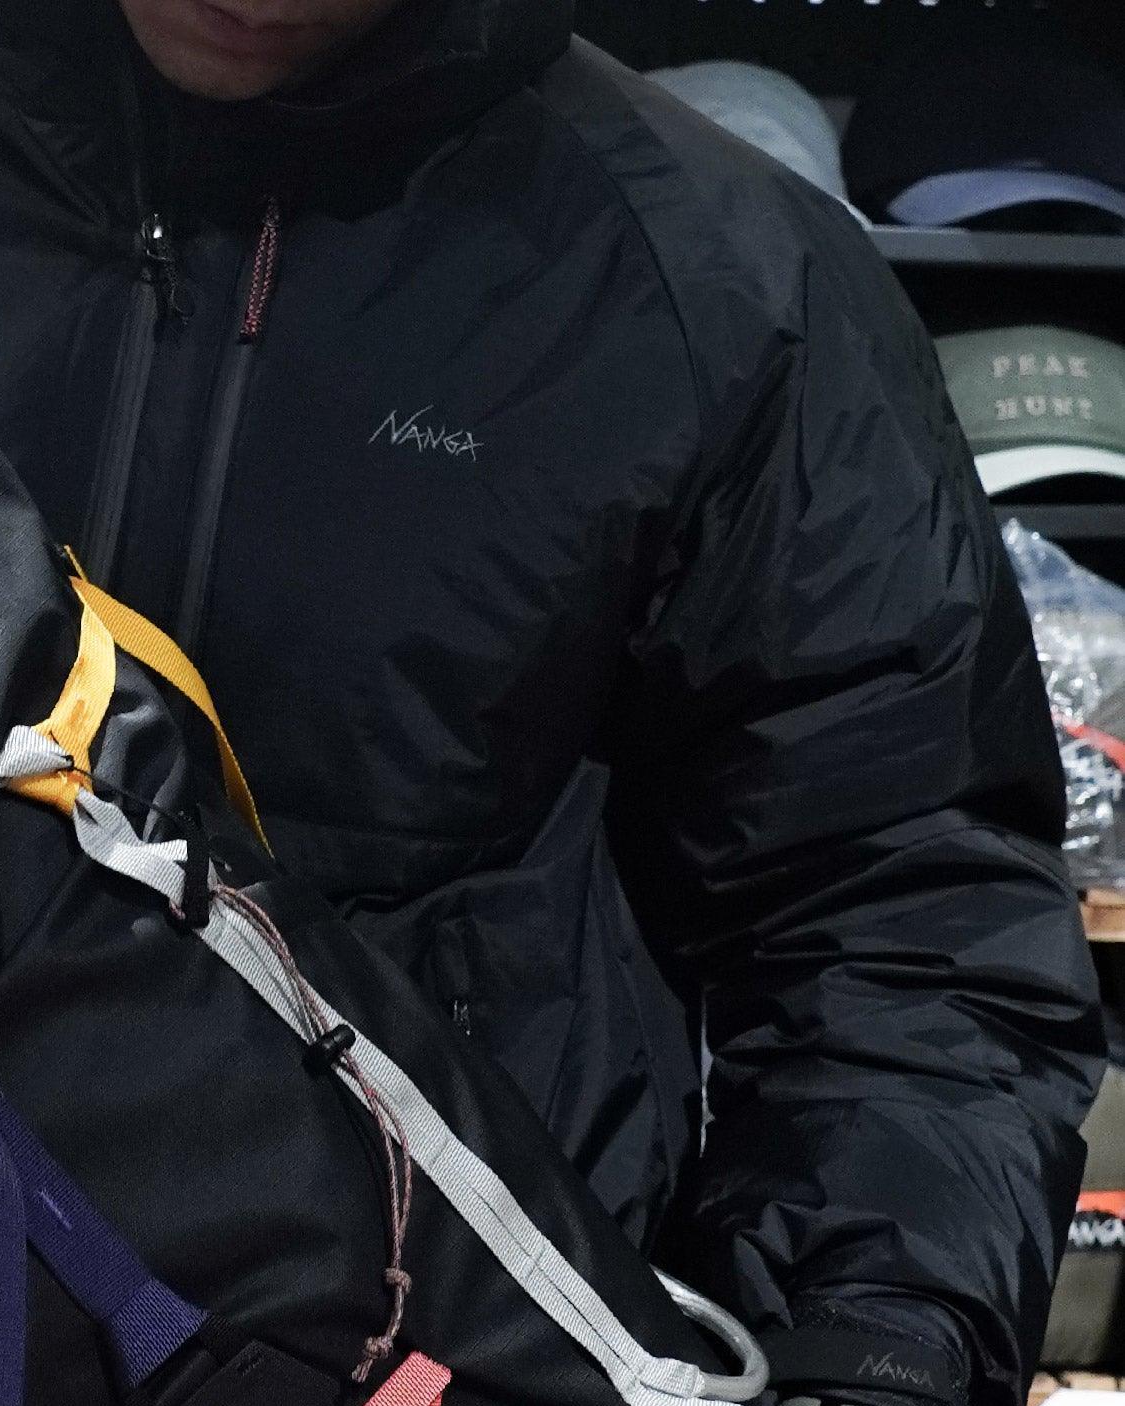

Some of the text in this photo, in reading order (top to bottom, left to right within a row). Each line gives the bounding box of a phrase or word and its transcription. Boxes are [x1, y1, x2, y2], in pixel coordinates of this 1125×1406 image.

[992, 353, 1089, 379] PEAK
[368, 404, 485, 462] NANGA
[856, 1351, 935, 1390] NANGA
